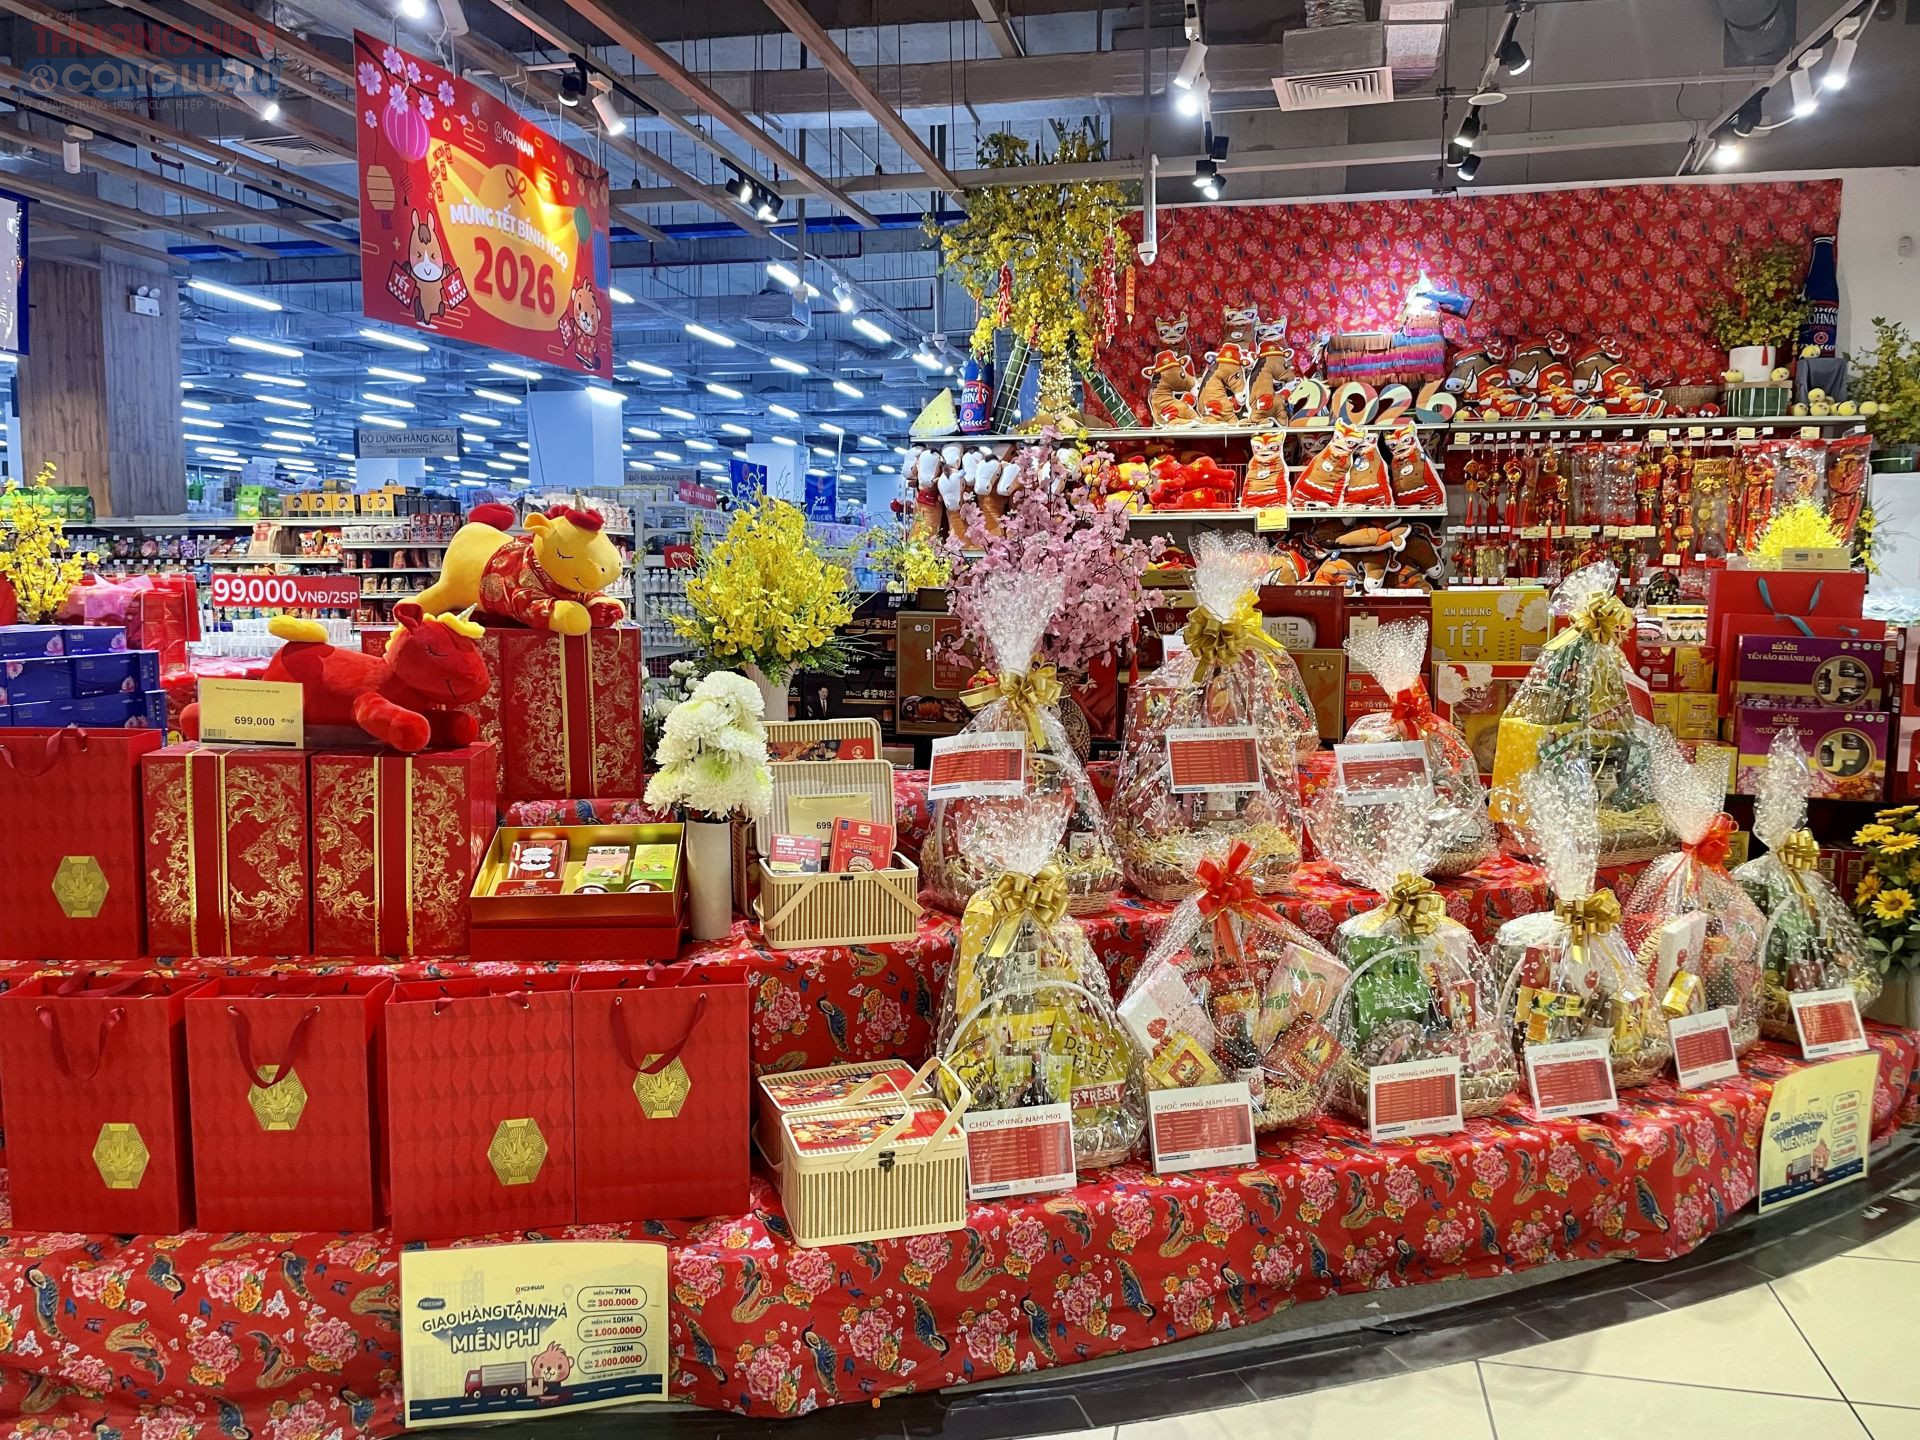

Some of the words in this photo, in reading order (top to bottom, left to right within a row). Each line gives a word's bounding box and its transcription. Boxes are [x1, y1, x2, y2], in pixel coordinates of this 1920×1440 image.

[502, 127, 535, 158] KOHNAN
[449, 197, 495, 229] MỪNG
[495, 205, 517, 232] TẾT
[517, 216, 545, 249] BÍNH
[393, 271, 410, 292] TẾT
[448, 274, 462, 294] TẾT
[472, 236, 557, 317] 2026
[403, 432, 430, 444] HÀNG
[1443, 607, 1457, 616] AN
[1459, 607, 1492, 616] KHANG
[1446, 619, 1488, 647] TẾT
[234, 715, 275, 727] 699,000
[614, 1288, 631, 1296] 7KM
[597, 1298, 639, 1307] 300.000Đ
[422, 1311, 457, 1333] GIAO
[460, 1304, 502, 1327] HÀNG
[505, 1300, 535, 1322] TẬN
[538, 1302, 568, 1319] NHÀ
[612, 1316, 634, 1324] 10KM
[450, 1327, 501, 1353] MIỄN
[505, 1323, 540, 1349] PHÍ
[594, 1326, 642, 1337] 1.000.000Đ
[612, 1345, 634, 1354] 20KM
[594, 1354, 642, 1369] 2.000.000Đ
